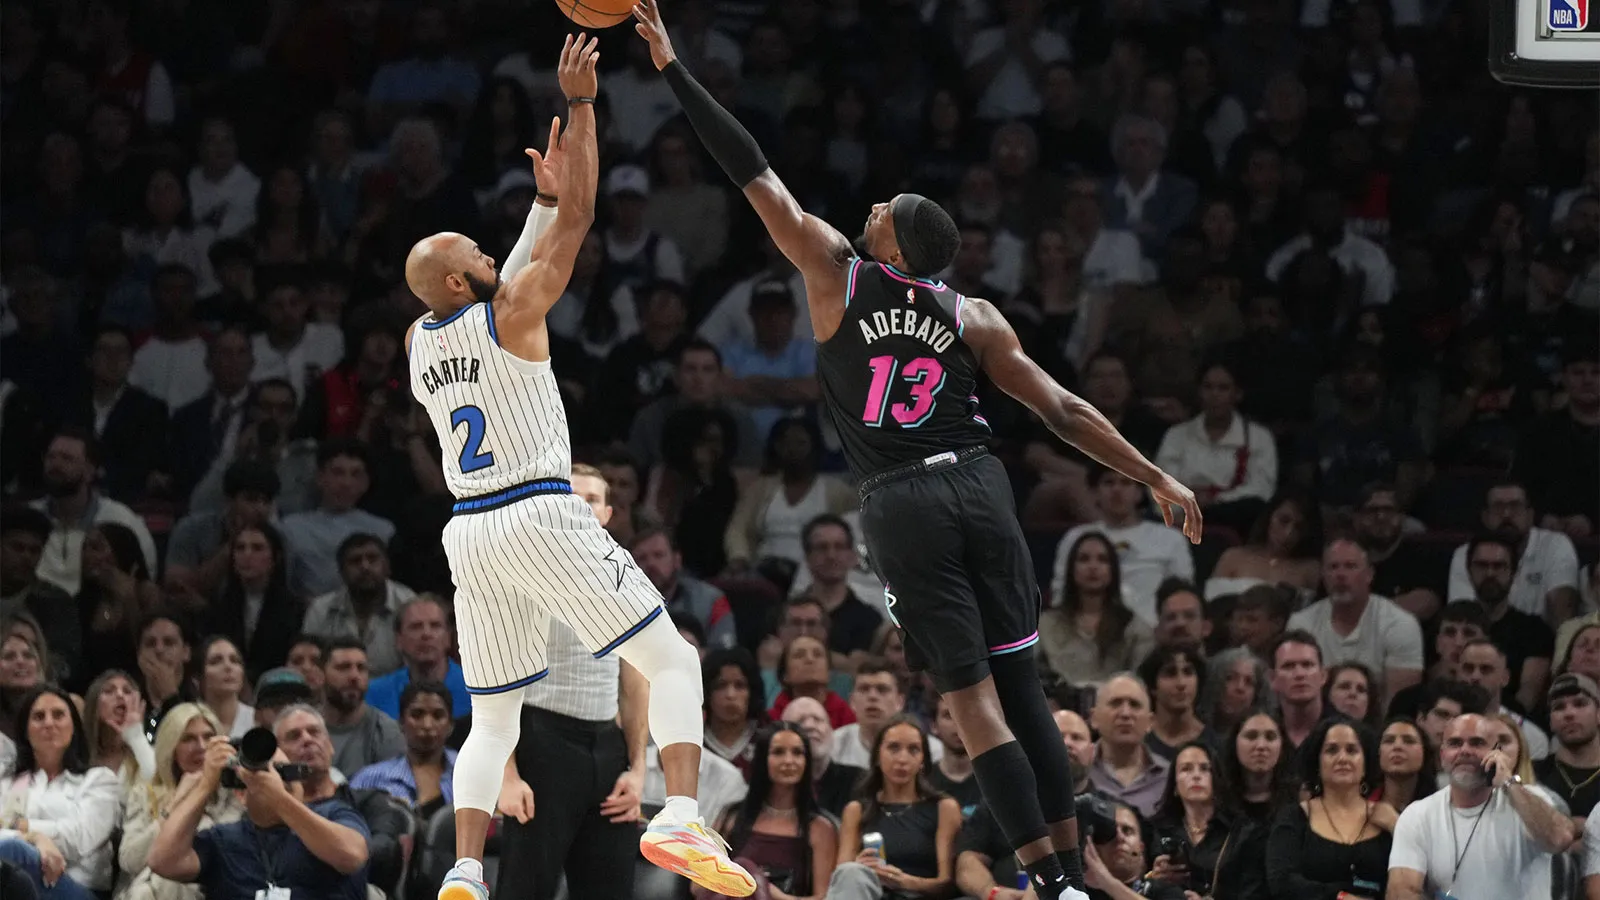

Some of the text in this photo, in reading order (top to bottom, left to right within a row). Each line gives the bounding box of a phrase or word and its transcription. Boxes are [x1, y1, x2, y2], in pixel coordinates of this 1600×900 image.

[1553, 9, 1573, 25] NBA
[858, 308, 955, 354] ADEBAYO
[422, 356, 480, 395] CARTER
[862, 355, 947, 428] 13
[450, 404, 495, 474] 2
